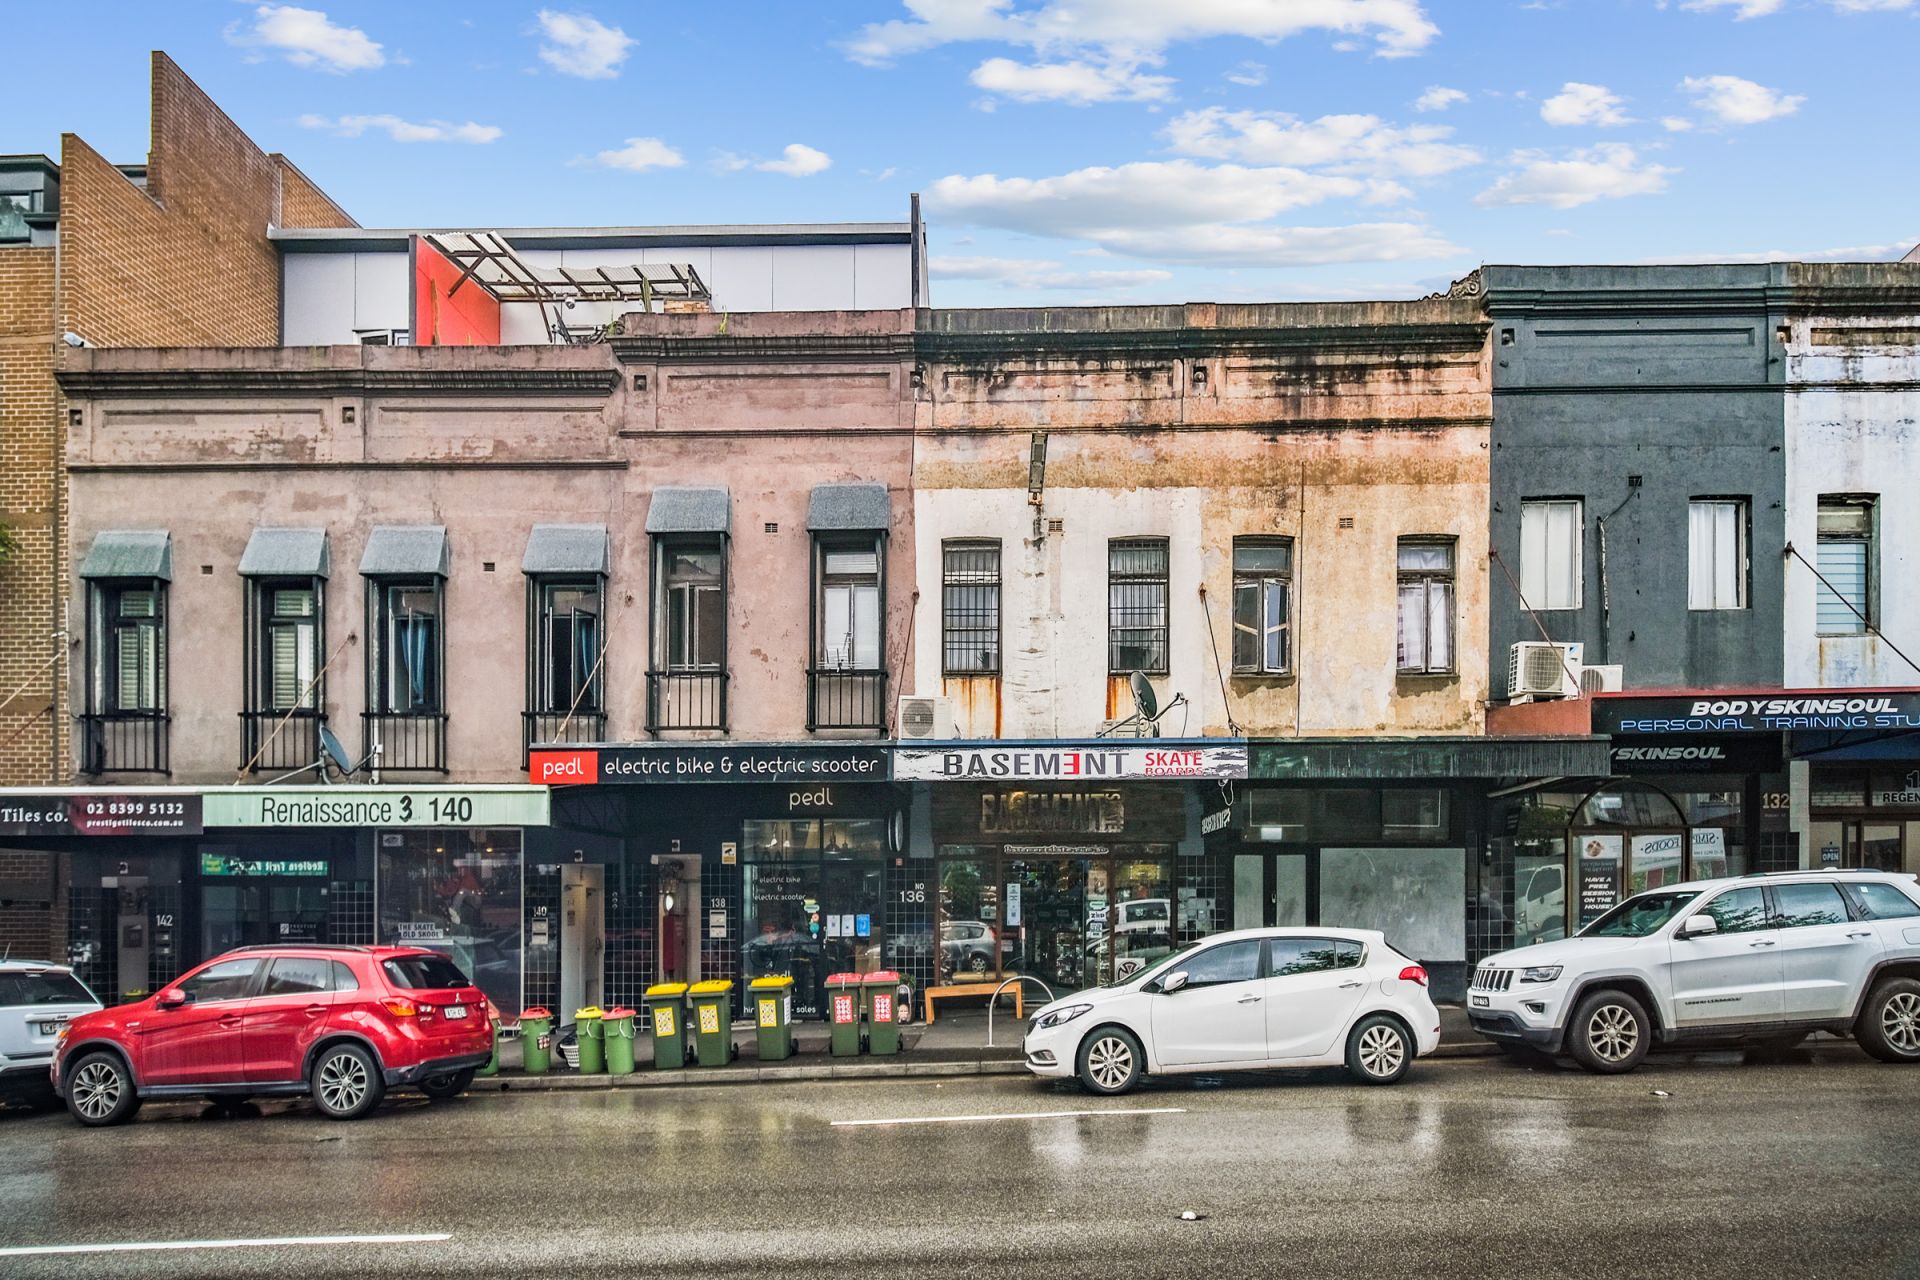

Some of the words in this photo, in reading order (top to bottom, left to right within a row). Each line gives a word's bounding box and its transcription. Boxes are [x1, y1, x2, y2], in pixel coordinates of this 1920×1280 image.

[1690, 699, 1899, 716] BODYSKINSOUL
[1620, 718, 1753, 732] PERSONAL
[1760, 715, 1868, 728] TRAINING
[605, 757, 670, 774] electric
[676, 757, 714, 774] bike
[721, 757, 734, 774] &
[740, 756, 806, 773] electric
[811, 756, 878, 773] scooter
[944, 753, 1130, 776] BASEMENT
[1145, 752, 1202, 766] SKATE
[543, 757, 584, 780] pedl
[1145, 767, 1204, 777] BOARDS
[789, 788, 833, 810] pedl
[1762, 792, 1790, 809] 132
[1, 808, 41, 823] Tiles
[45, 810, 69, 823] co.
[86, 803, 104, 815] 02
[109, 803, 144, 815] 8399
[149, 803, 184, 815] 5132
[261, 797, 391, 823] Renaissance
[399, 795, 413, 823] 3
[428, 797, 473, 822] 140
[86, 818, 184, 829] prestigetilesco.com.au
[915, 882, 925, 890] NO
[711, 898, 726, 908] 138
[900, 890, 925, 903] 136
[156, 914, 173, 927] 142
[414, 923, 434, 931] SKATE
[743, 1005, 755, 1013] hir
[796, 1005, 816, 1013] sales
